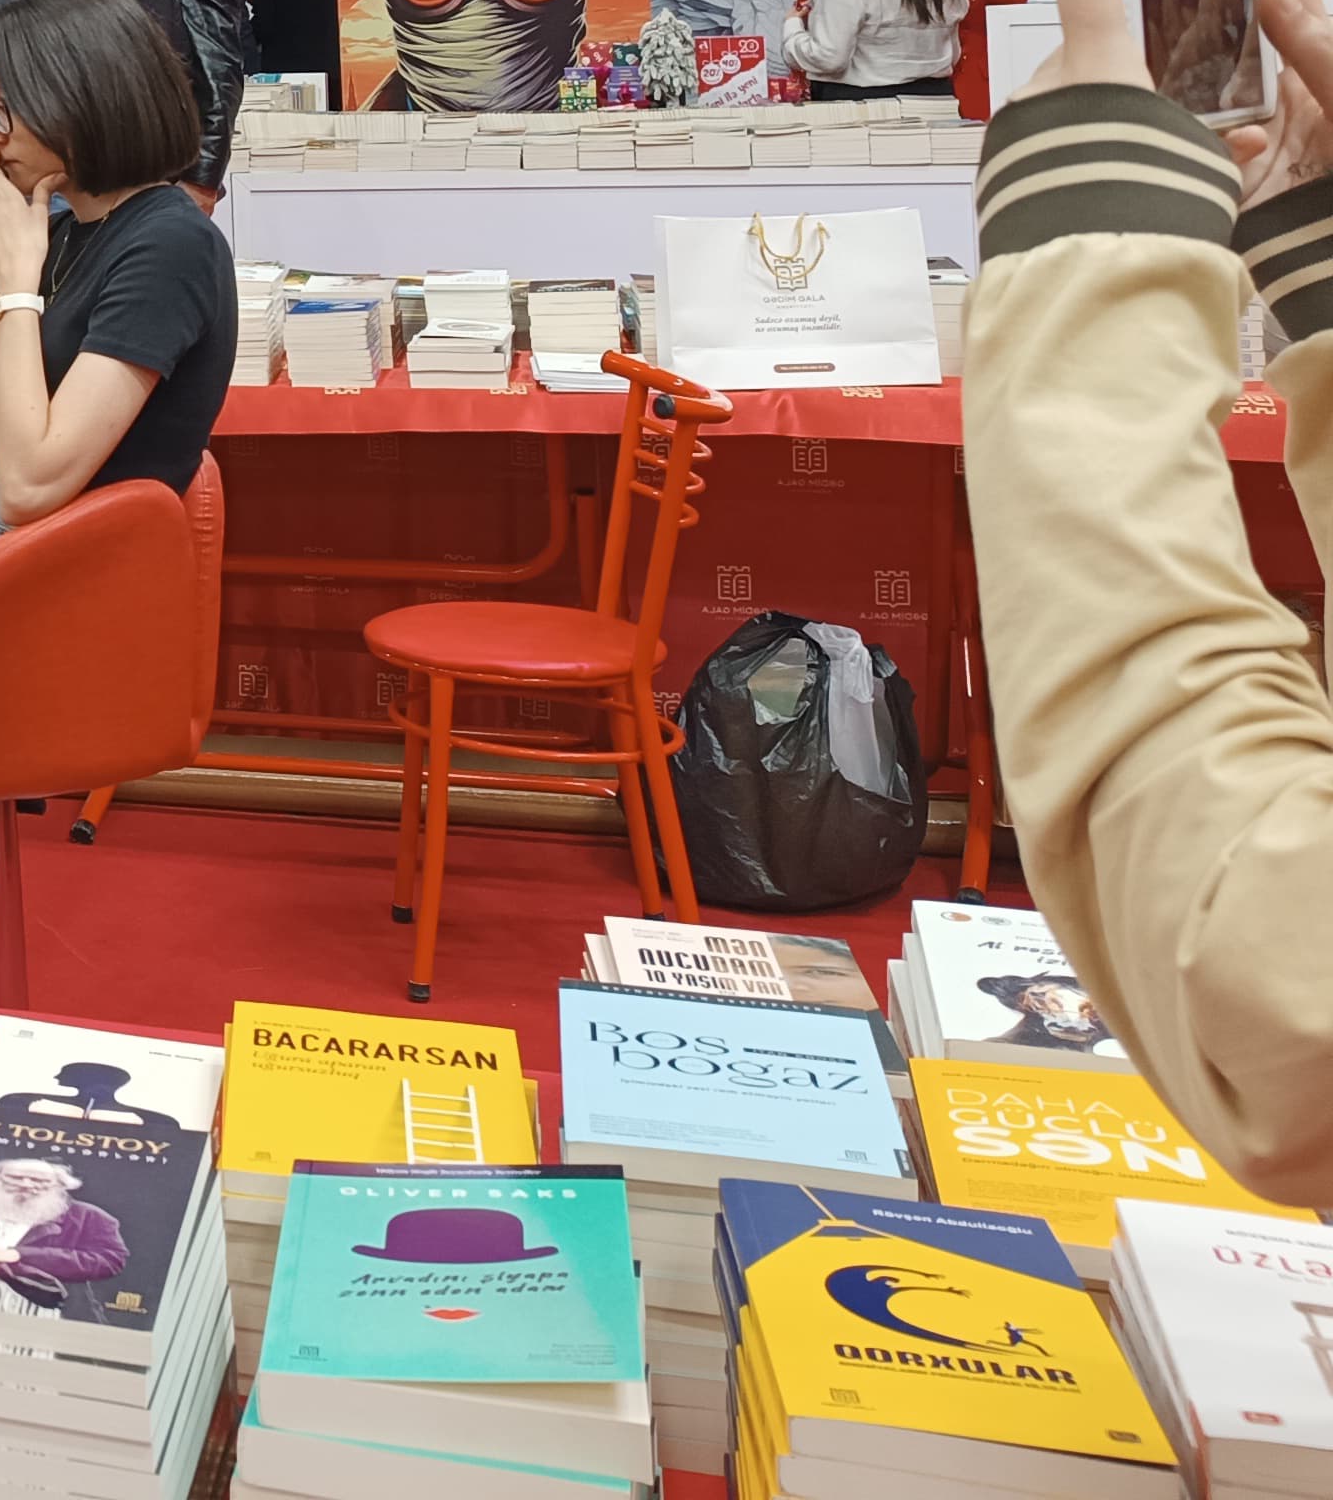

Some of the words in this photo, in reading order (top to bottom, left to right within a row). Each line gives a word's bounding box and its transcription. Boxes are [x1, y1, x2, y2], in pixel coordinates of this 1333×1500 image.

[704, 934, 769, 958] MƏN
[741, 980, 785, 996] VAR
[252, 1027, 500, 1071] BACARARSAN
[946, 1088, 1124, 1119] DAHA
[7, 1123, 173, 1155] TOLSTOY
[952, 1126, 1207, 1181] SƏN
[488, 1188, 579, 1199] SAKS
[833, 1342, 1079, 1388] QORXULAR
